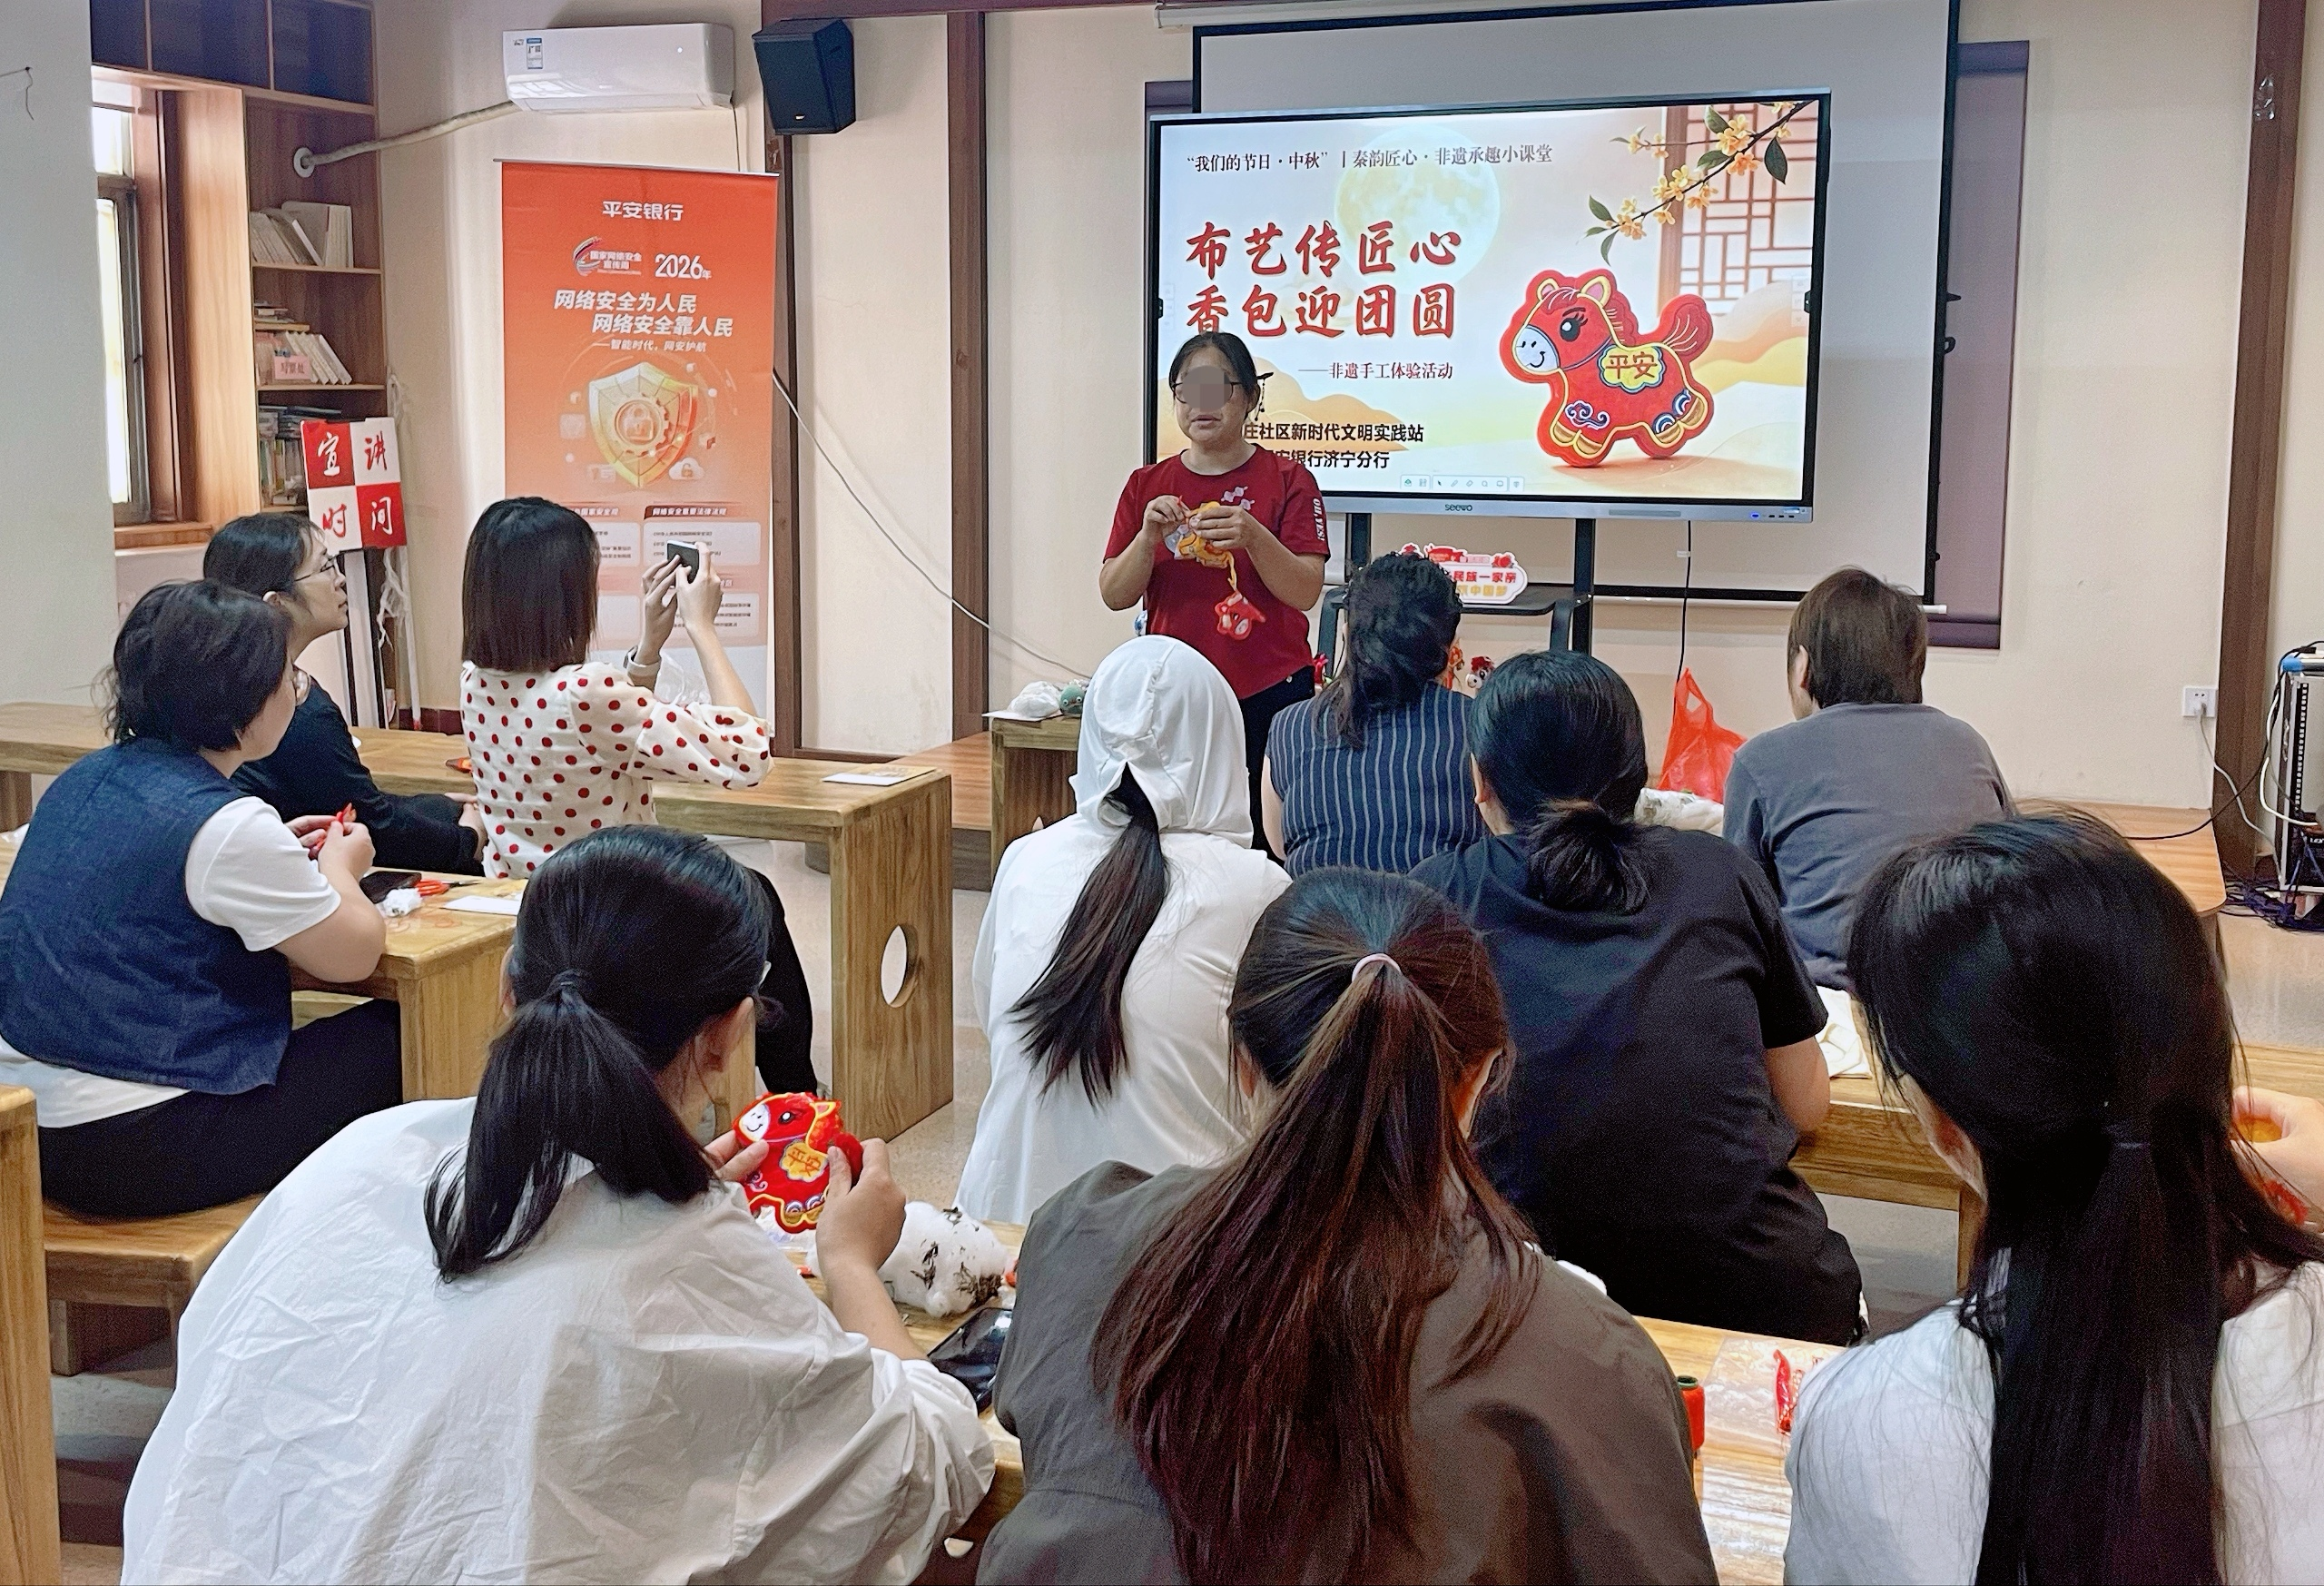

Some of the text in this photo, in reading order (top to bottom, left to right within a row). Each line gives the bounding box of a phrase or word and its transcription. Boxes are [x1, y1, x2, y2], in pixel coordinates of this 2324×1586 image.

[602, 201, 684, 222] 平安银行
[1186, 220, 1462, 280] 布艺传匠心
[554, 289, 697, 314] 网络安全为人民
[1186, 282, 1457, 340] 香包迎团圆
[592, 313, 734, 337] 网络安全靠人民
[1605, 351, 1658, 379] 平安
[317, 430, 388, 478] 宣讲
[321, 497, 393, 538] 时间
